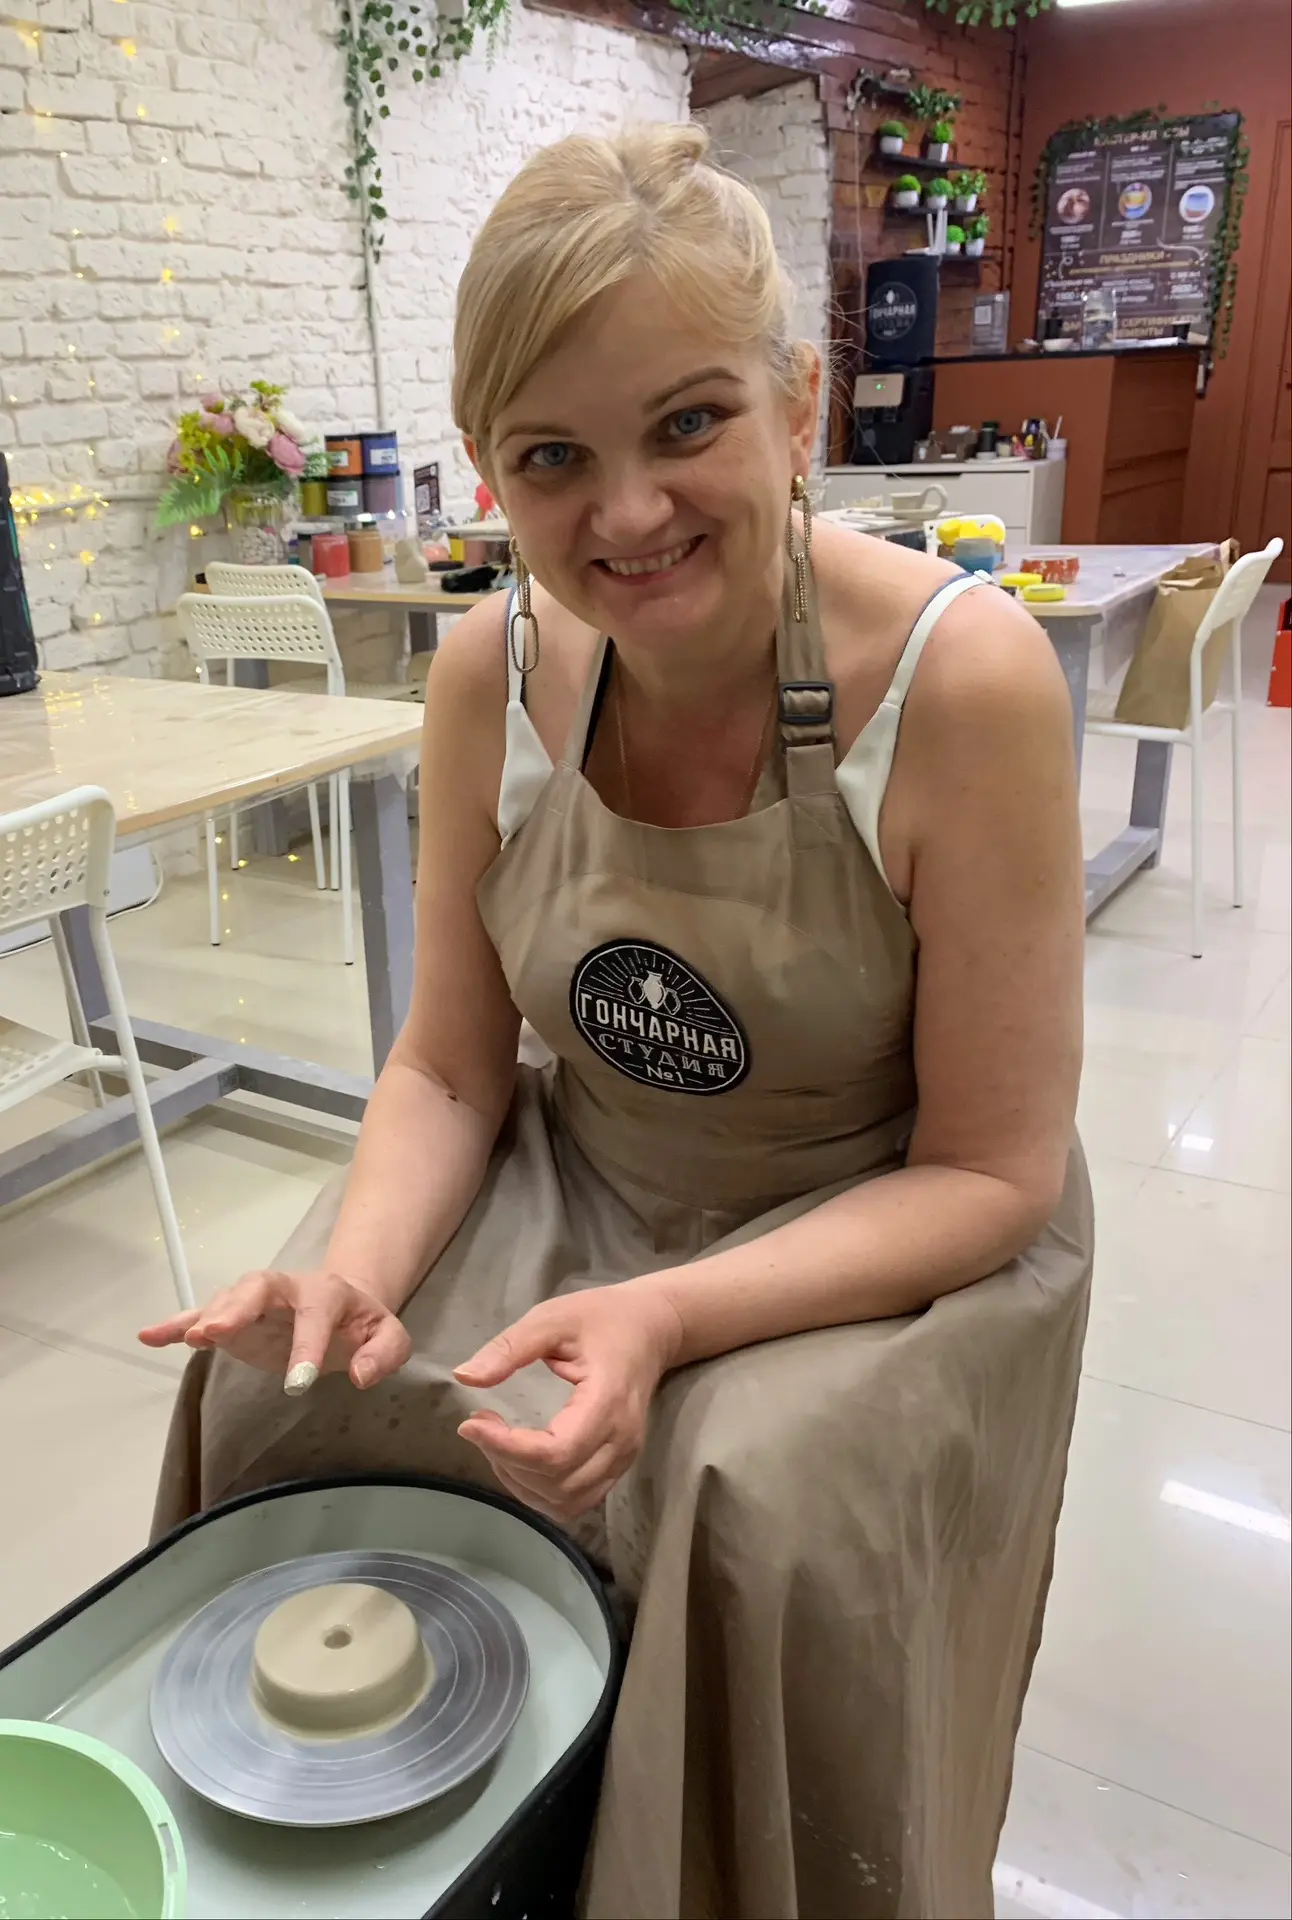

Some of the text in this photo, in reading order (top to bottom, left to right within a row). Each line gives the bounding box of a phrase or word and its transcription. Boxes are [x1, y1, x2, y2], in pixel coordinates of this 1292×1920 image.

[580, 993, 738, 1060] ГОНЧАРНАЯ
[598, 1033, 727, 1079] СТУДИЯ
[646, 1063, 685, 1085] №1
